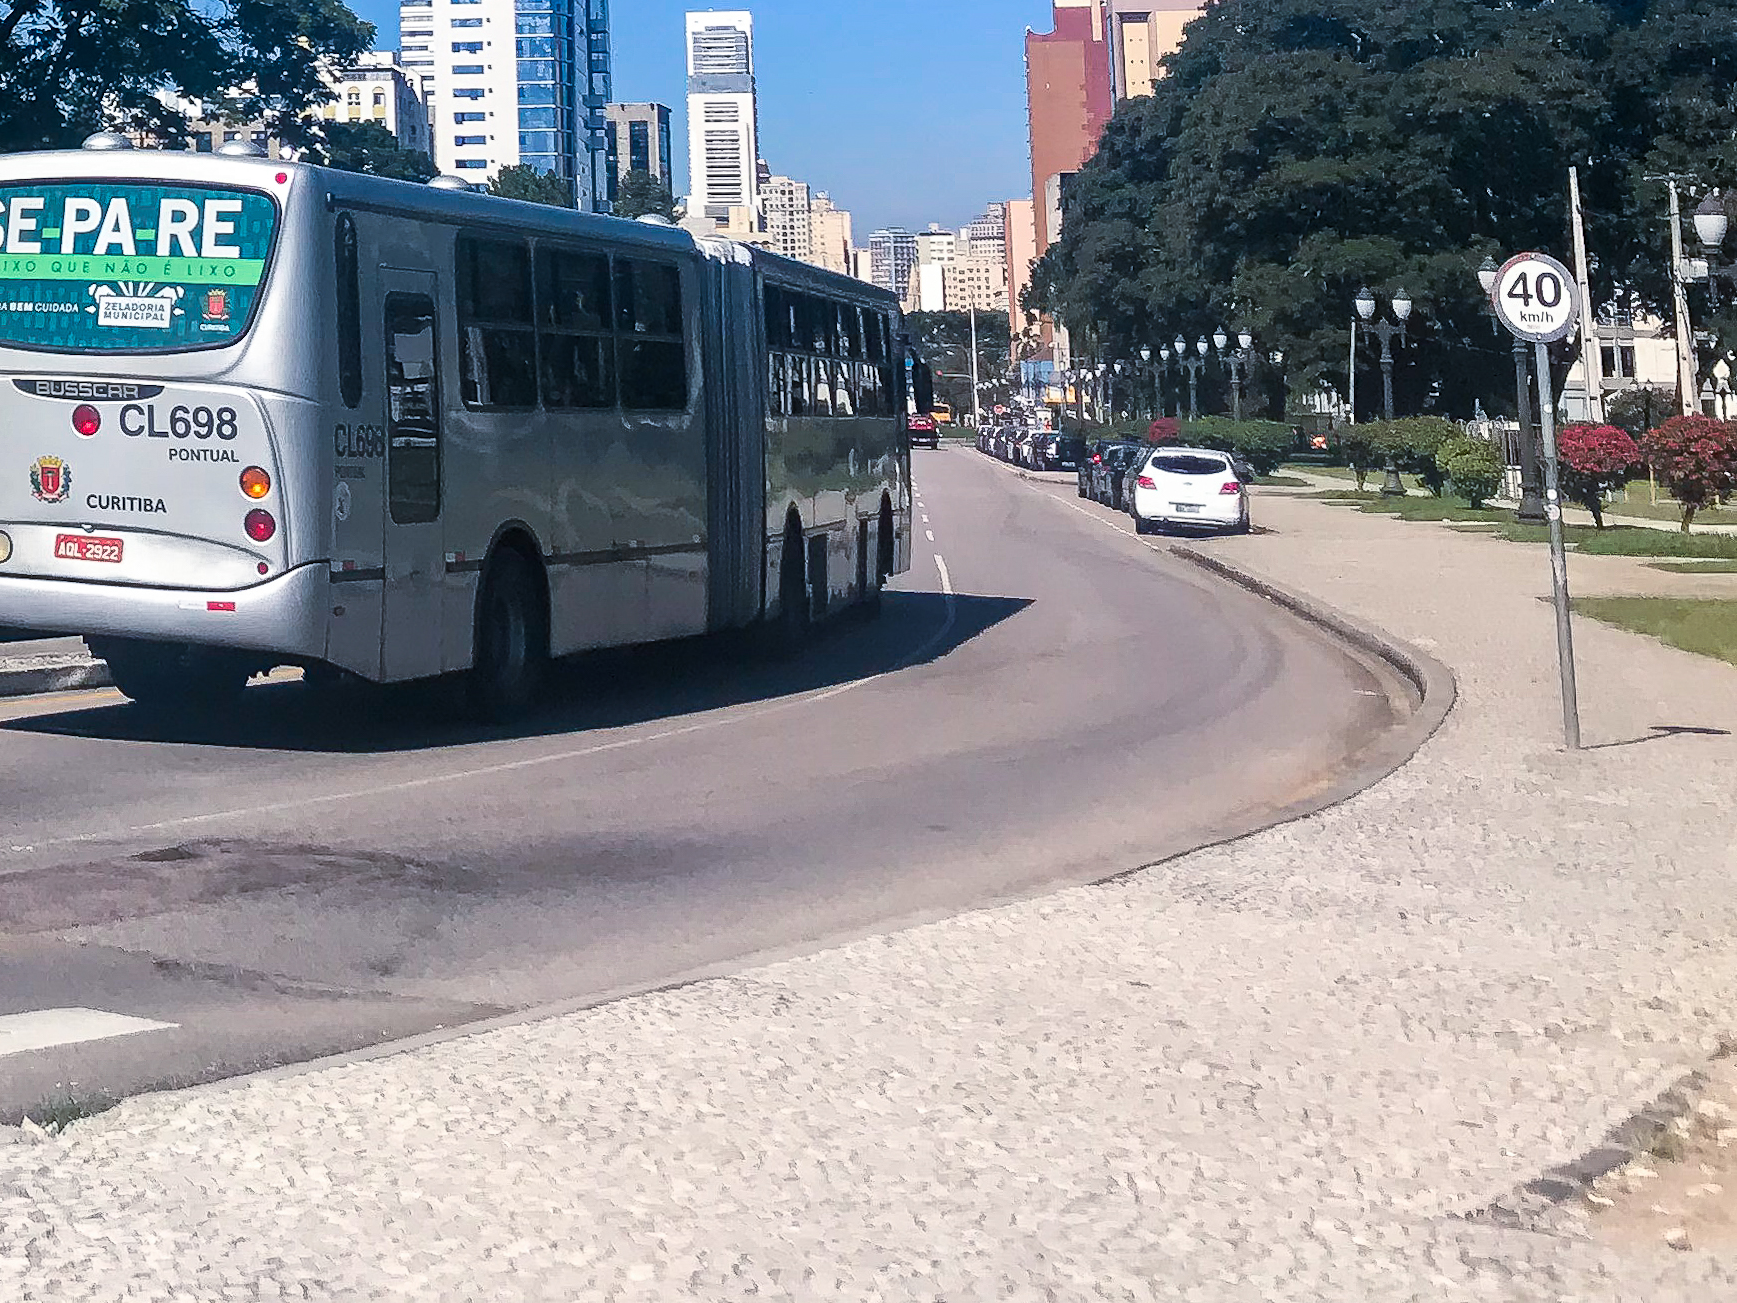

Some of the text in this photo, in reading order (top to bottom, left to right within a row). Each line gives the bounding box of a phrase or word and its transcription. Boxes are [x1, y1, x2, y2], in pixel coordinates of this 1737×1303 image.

[51, 261, 90, 273] QUE
[105, 260, 147, 274] NÃO
[164, 260, 172, 275] É
[187, 264, 235, 277] LIXO
[1507, 271, 1561, 307] 40
[34, 302, 79, 312] CUIDADA
[104, 302, 164, 311] ZELADORIA
[104, 311, 164, 320] MUNICIPAL
[1520, 311, 1553, 322] km/h
[36, 381, 138, 397] BUSSCAR
[120, 403, 238, 440] CL698
[169, 448, 239, 462] PONTUAL
[86, 494, 166, 513] CURITIBA
